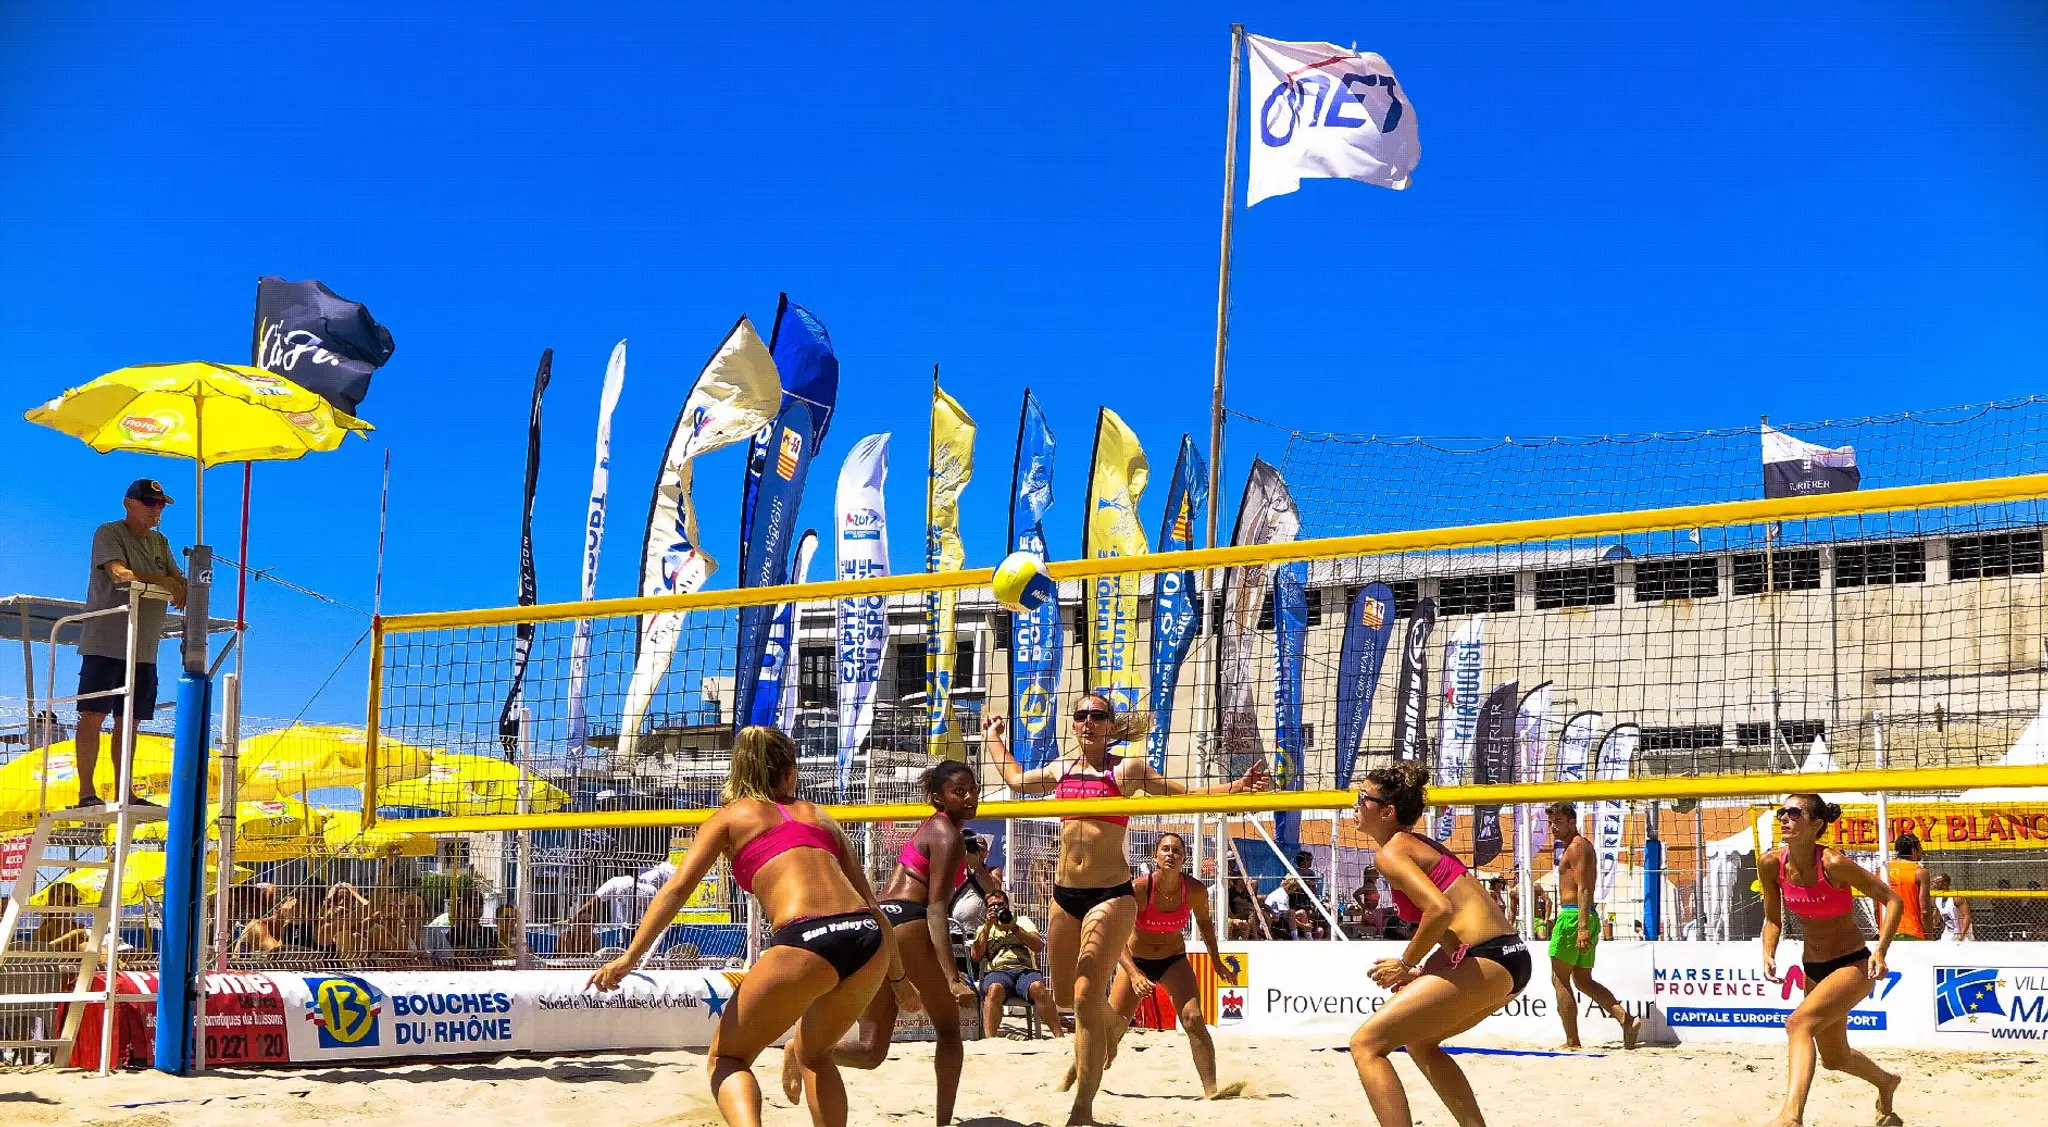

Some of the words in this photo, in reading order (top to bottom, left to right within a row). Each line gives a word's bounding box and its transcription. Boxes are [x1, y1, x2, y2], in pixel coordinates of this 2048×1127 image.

[866, 559, 884, 641] SPOT
[843, 559, 857, 682] CAPITAE
[1487, 703, 1502, 784] URTERER
[1604, 800, 1621, 876] OREZZ
[801, 926, 828, 942] Sun
[828, 920, 862, 934] Valley
[1655, 968, 1761, 981] MARSEILL
[1267, 988, 1386, 1014] Provence
[1655, 983, 1766, 996] PROVENCE
[392, 993, 511, 1017] BOUCHES
[538, 994, 580, 1012] Société
[582, 993, 648, 1009] Marseillaise
[650, 993, 663, 1008] de
[665, 992, 698, 1008] Crédit
[1672, 1011, 1730, 1023] CAPITALE
[1732, 1008, 1788, 1024] EUROPÉE
[1847, 1015, 1878, 1027] PORT
